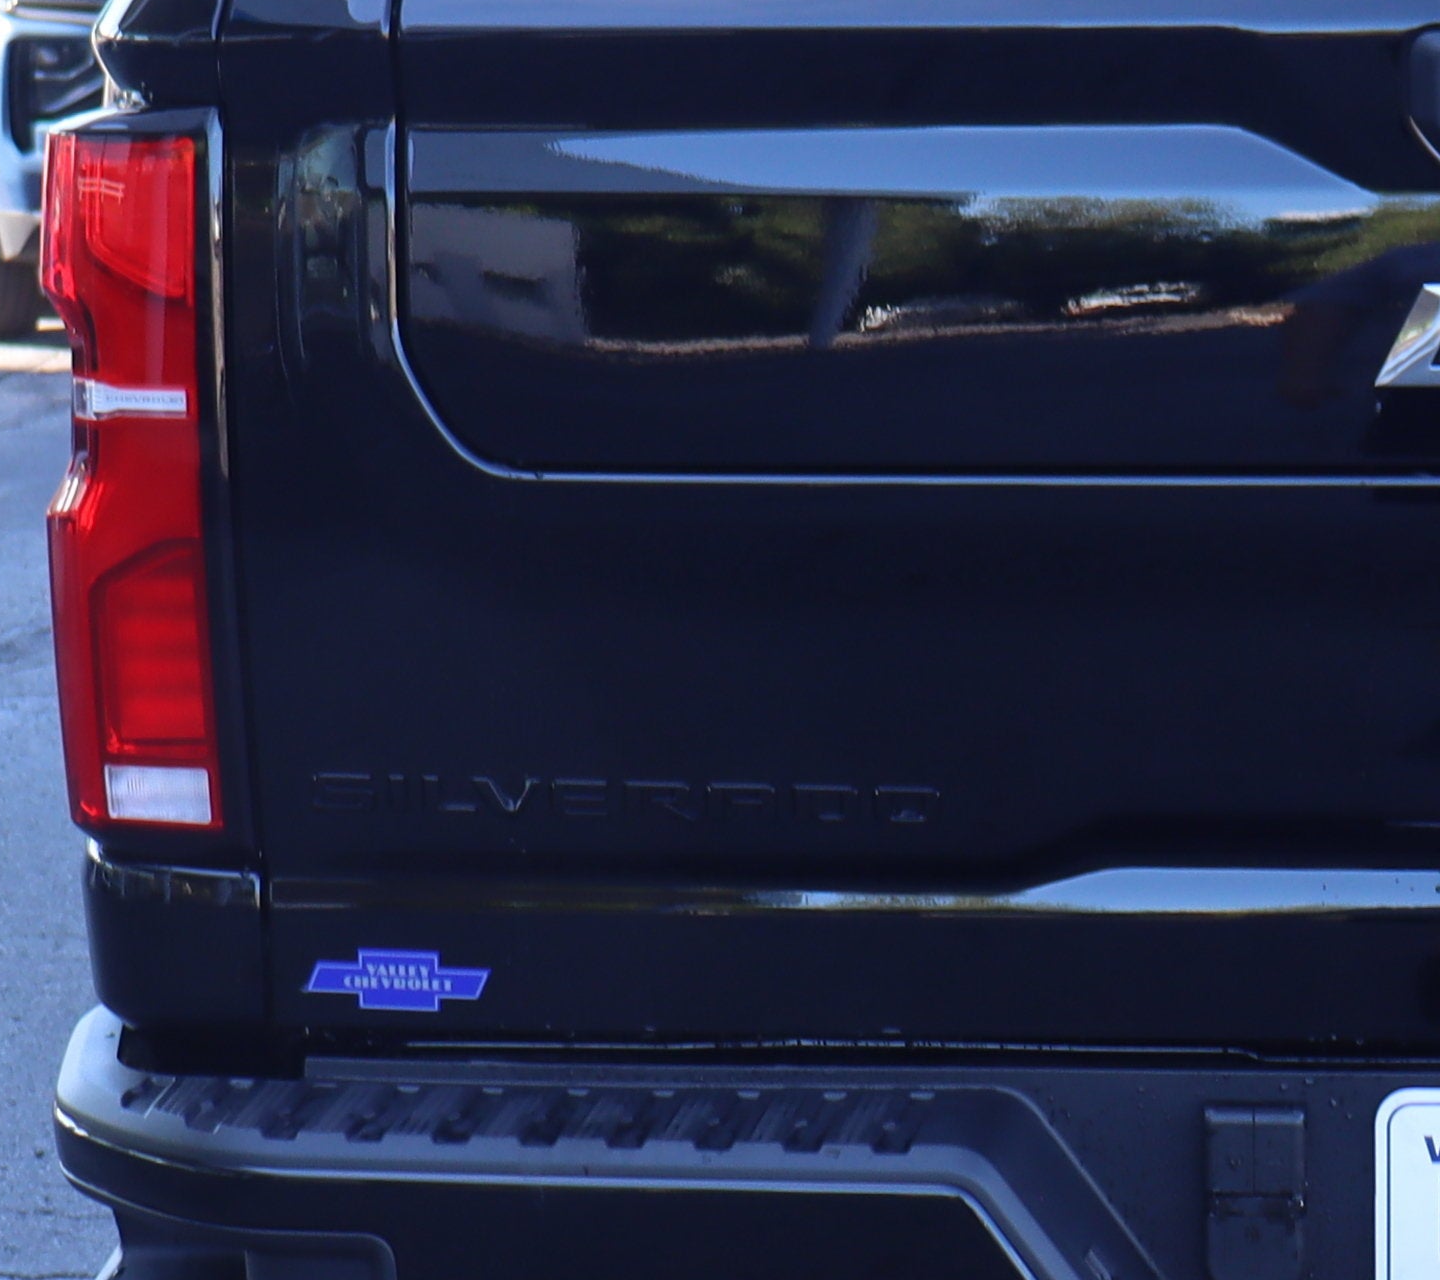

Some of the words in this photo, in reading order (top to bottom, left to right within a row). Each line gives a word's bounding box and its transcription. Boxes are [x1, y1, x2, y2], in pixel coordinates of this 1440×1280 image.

[312, 770, 941, 824] SILVERADO
[366, 962, 430, 979] VALLEY
[342, 974, 453, 992] CHEVROLET
